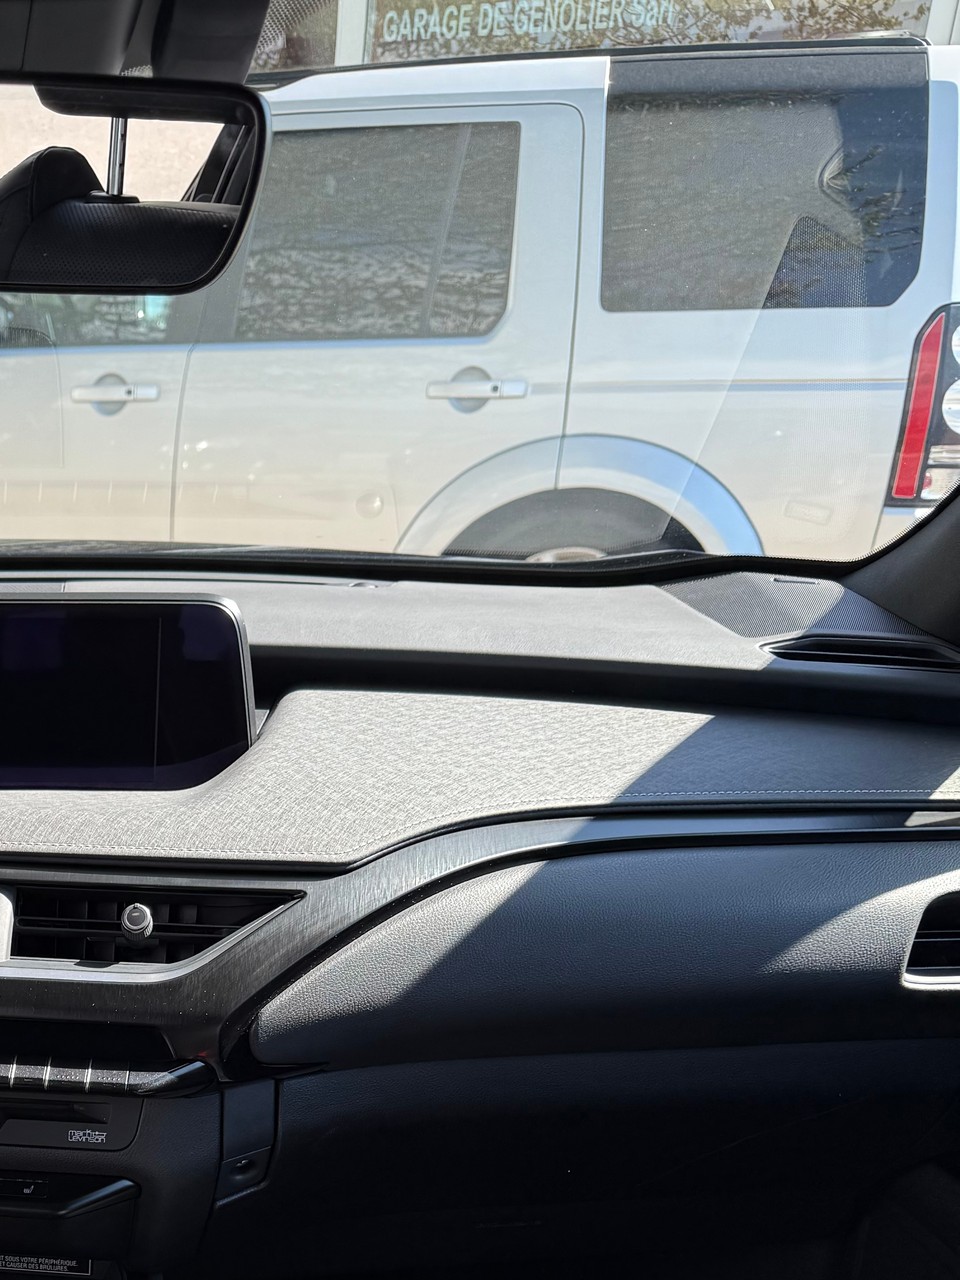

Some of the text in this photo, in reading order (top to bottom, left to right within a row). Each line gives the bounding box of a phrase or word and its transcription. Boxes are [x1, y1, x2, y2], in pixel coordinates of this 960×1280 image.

[383, 3, 473, 42] GARAGE
[477, 2, 507, 37] DE
[514, 0, 624, 35] GENOLIER
[6, 1261, 27, 1269] CAUSER
